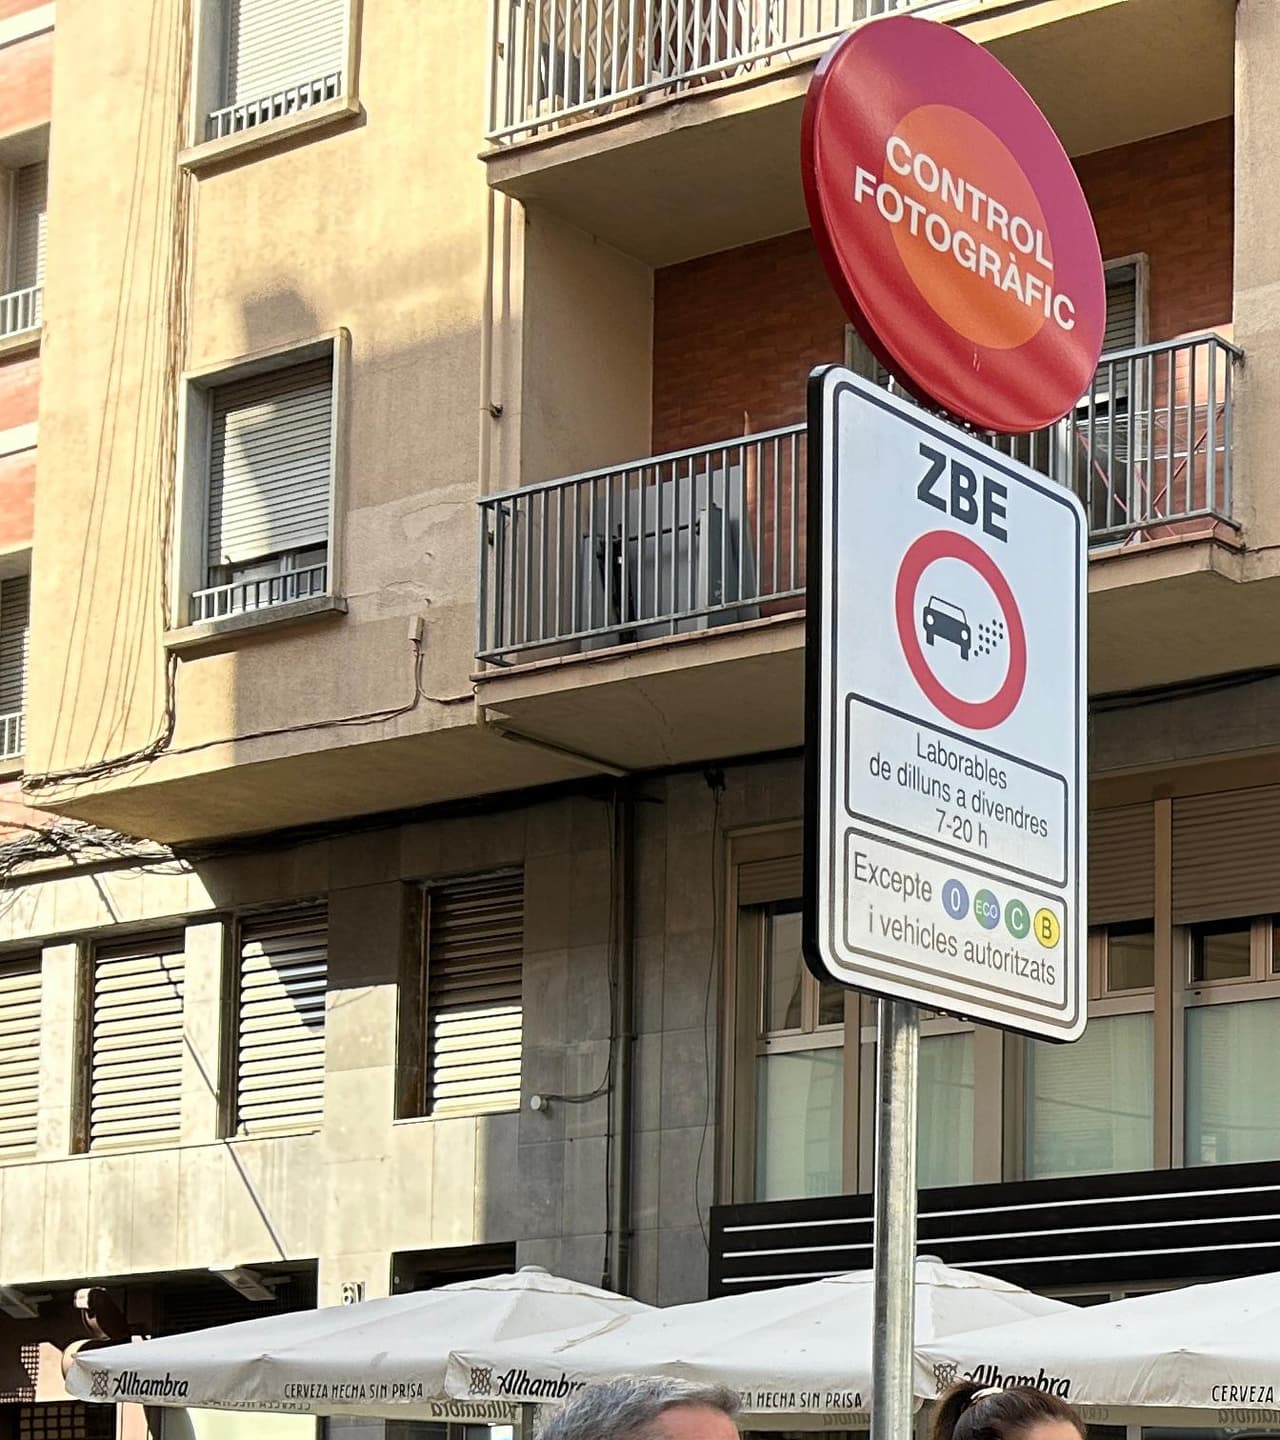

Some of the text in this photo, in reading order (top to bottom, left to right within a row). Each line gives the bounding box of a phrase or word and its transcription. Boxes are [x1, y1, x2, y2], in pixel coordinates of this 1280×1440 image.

[886, 134, 1054, 270] CONTROL
[854, 166, 1076, 331] FOTOGRÀFIC
[917, 442, 1008, 543] ZBE
[869, 752, 1048, 838] de dilluns a divendres
[916, 732, 1008, 790] Laborables
[935, 807, 988, 848] 7-20 h
[853, 851, 933, 902] Excepte
[975, 900, 998, 920] ECO
[1011, 907, 1023, 931] C
[1041, 916, 1052, 940] B
[868, 904, 1056, 986] i vehicles autoritzats
[112, 1372, 189, 1398] Alhambra
[284, 1383, 424, 1399] CERVEZA HECHA SIN PRISA
[756, 1391, 796, 1409] HECHA
[799, 1391, 821, 1409] SIN
[825, 1392, 863, 1409] PRISA
[1211, 1385, 1275, 1405] CERVEZA
